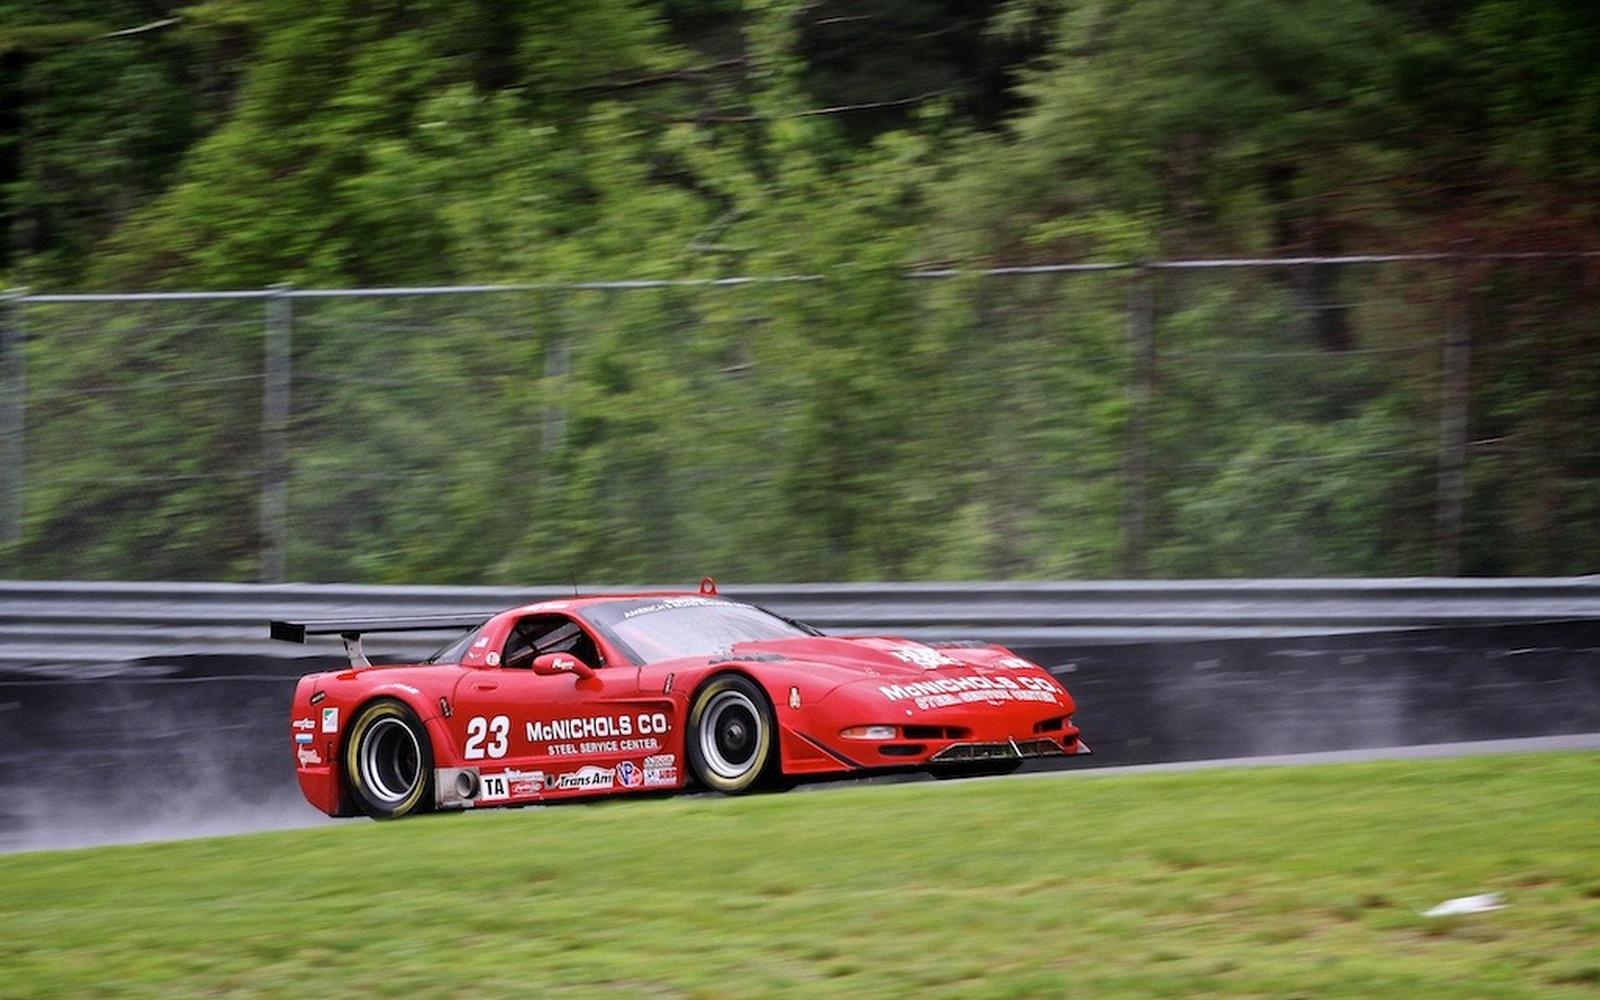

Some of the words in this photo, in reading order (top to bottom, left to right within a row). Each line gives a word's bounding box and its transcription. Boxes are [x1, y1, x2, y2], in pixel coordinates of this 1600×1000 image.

[879, 675, 1019, 701] McNICHOLS
[464, 715, 511, 760] 23
[525, 714, 632, 742] McNICHOLS
[637, 712, 672, 735] CO.
[547, 743, 578, 756] STEEL
[579, 740, 619, 754] SERVICE
[619, 738, 659, 751] CENTER
[484, 778, 505, 796] TA
[560, 775, 591, 788] Trans
[592, 772, 613, 784] Am
